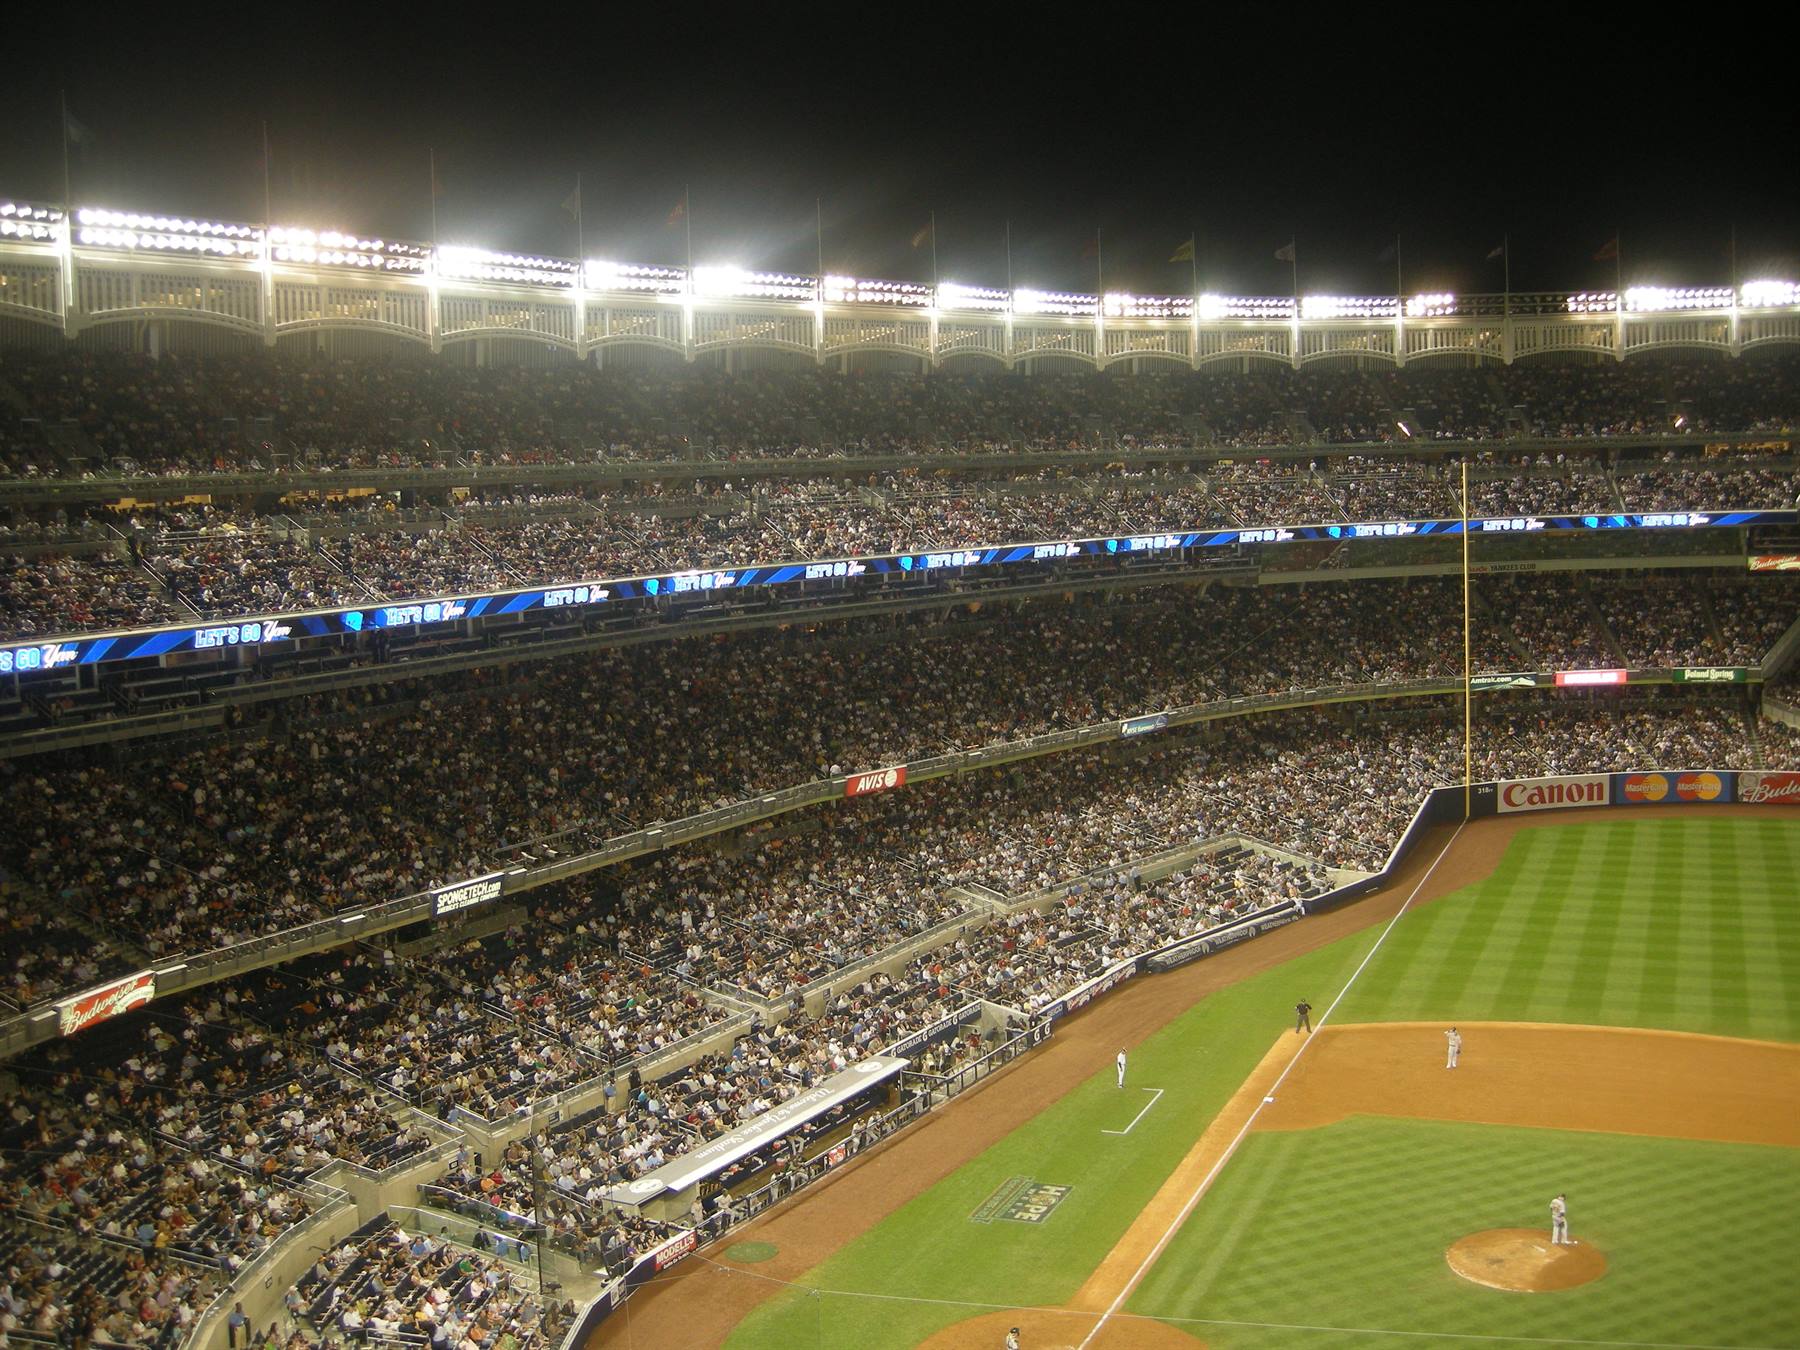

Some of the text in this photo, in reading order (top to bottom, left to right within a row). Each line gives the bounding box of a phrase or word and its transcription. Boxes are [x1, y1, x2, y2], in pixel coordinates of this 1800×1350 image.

[194, 626, 240, 648] LET'S
[241, 623, 261, 642] GO
[16, 647, 40, 669] GO
[1470, 676, 1512, 684] Amtrak.com
[1684, 669, 1734, 680] Poland Spring
[856, 773, 884, 793] AVIS
[1503, 782, 1604, 807] Canon
[1624, 783, 1668, 792] MasterCard
[1677, 783, 1721, 791] MasterCard
[437, 881, 501, 908] SPONGETECH.com
[60, 978, 138, 1036] Budweiser
[896, 1034, 922, 1054] GATORADE
[928, 1018, 952, 1037] GATORADE
[656, 1234, 696, 1264] MODELL'S
